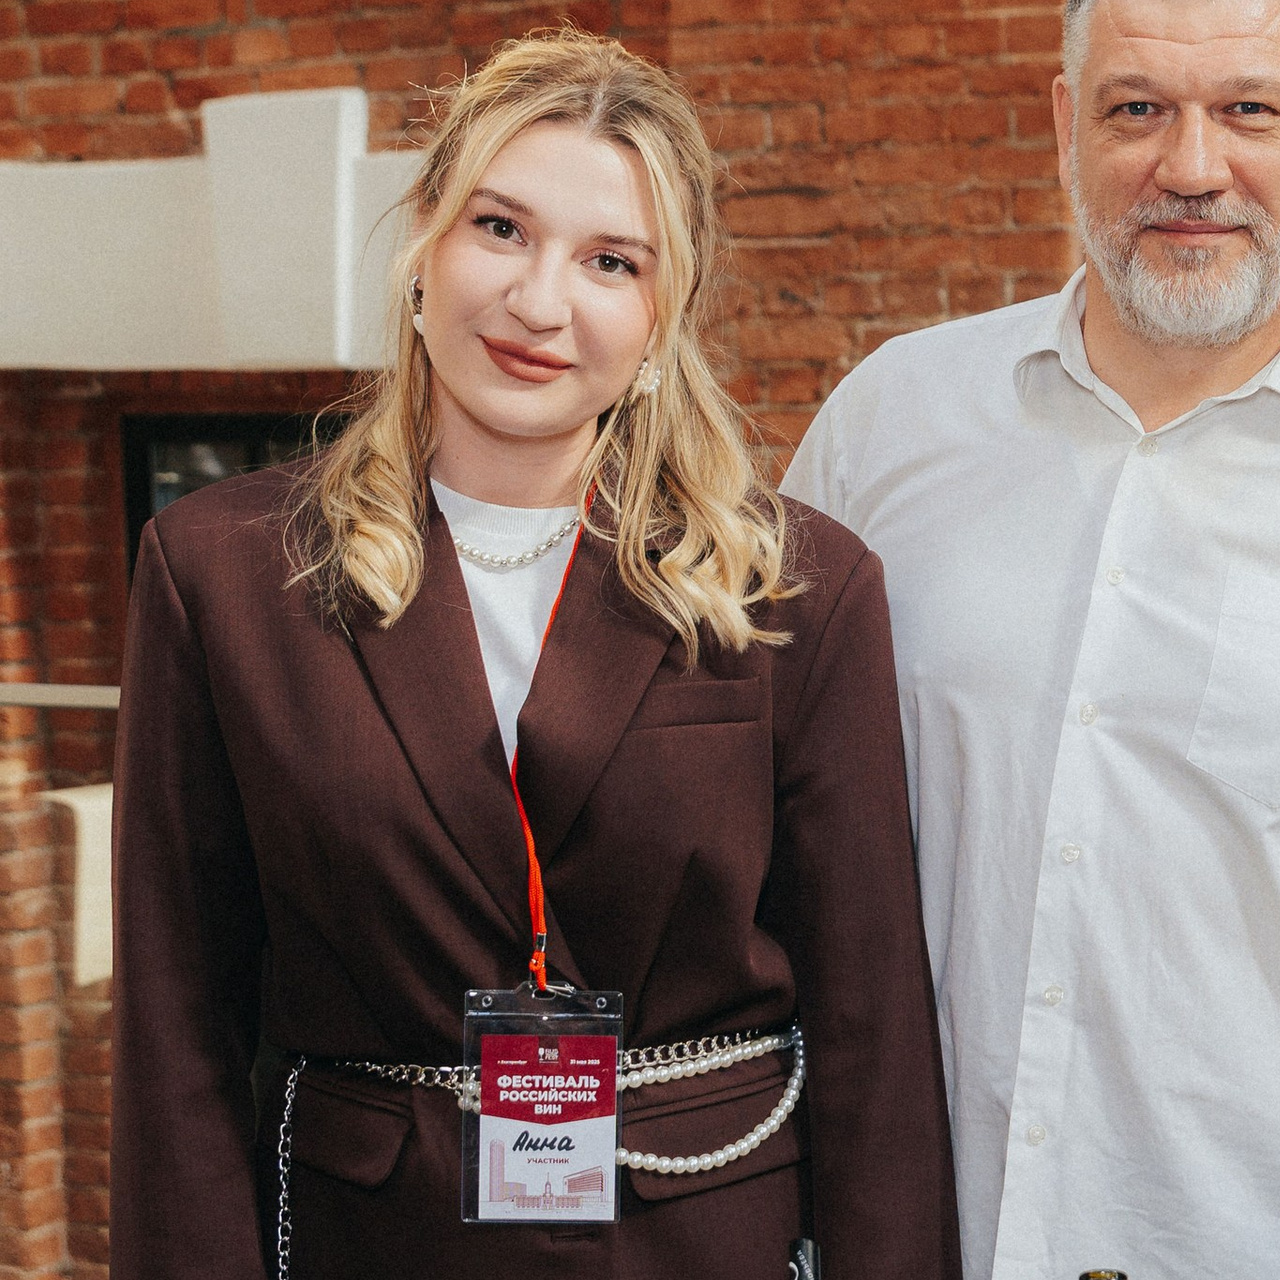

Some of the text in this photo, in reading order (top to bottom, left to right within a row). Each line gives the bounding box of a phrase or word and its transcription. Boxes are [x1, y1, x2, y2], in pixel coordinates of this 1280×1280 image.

[497, 1074, 601, 1089] ФЕСТИВАЛЬ
[499, 1088, 597, 1102] РОССИЙСКИХ
[534, 1103, 562, 1115] ВИН
[512, 1130, 576, 1152] Анна
